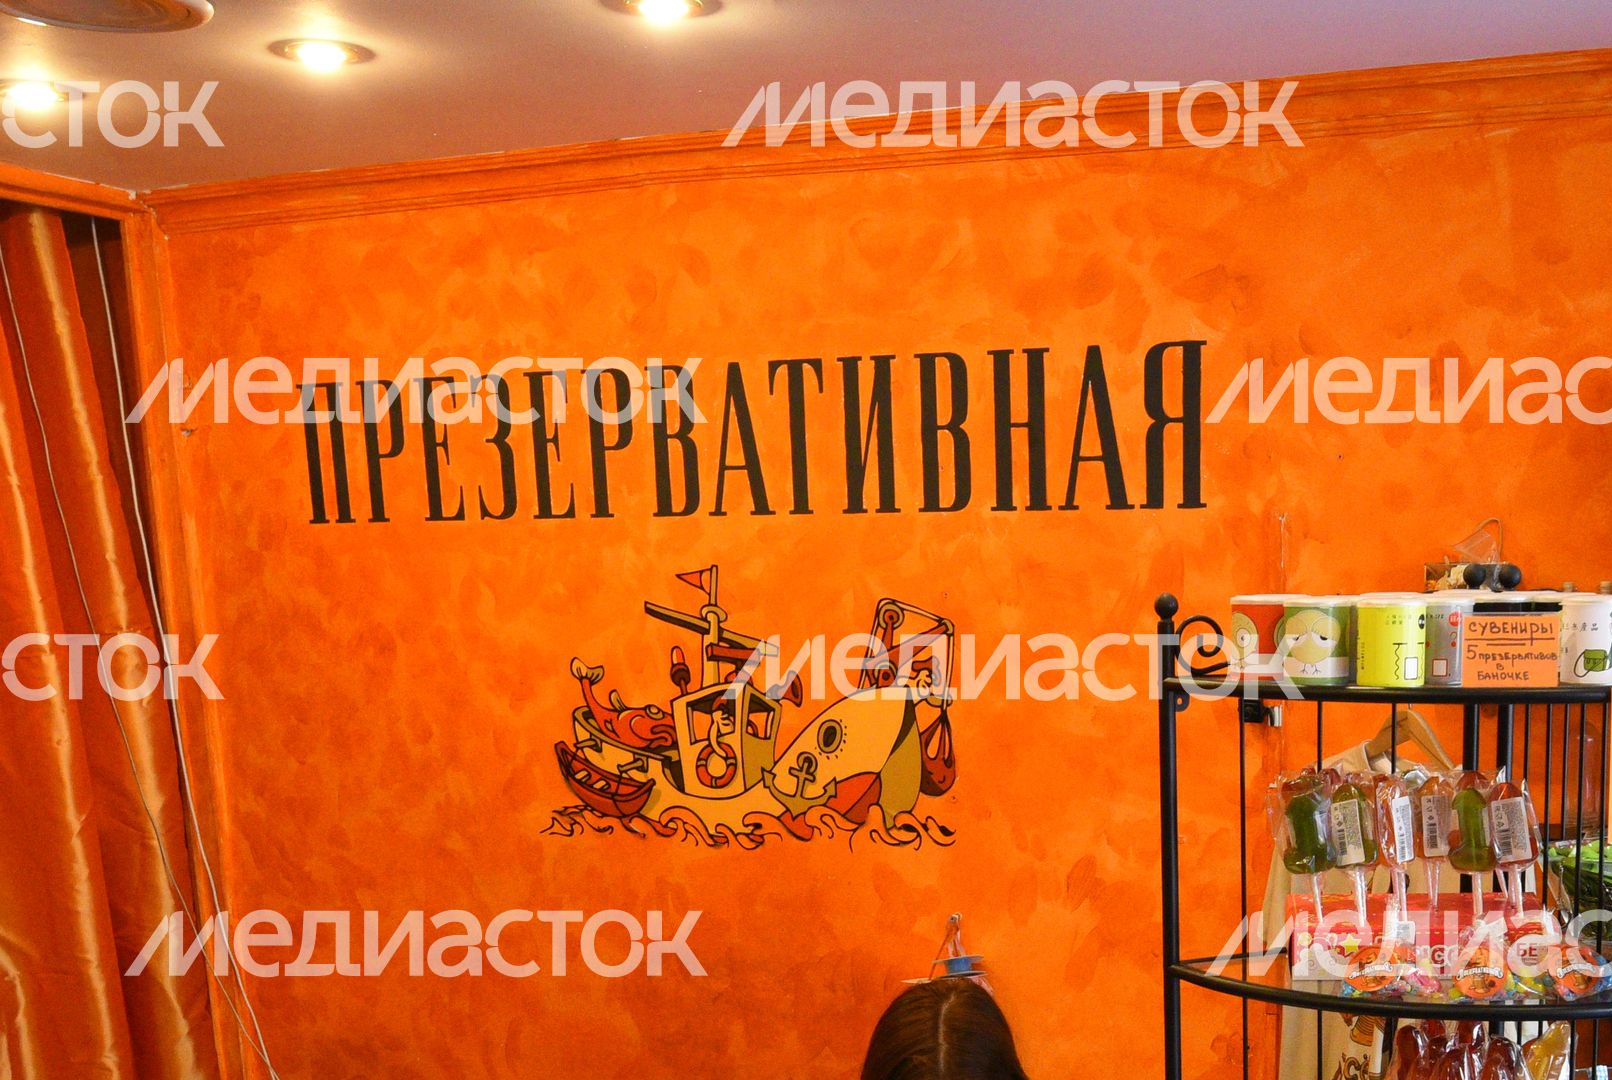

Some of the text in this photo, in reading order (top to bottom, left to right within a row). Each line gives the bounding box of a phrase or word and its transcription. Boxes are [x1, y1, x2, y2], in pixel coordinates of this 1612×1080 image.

[297, 341, 1206, 525] ПРЕЗЕРВАТИВНАЯ
[1466, 644, 1479, 661] 5
[1476, 670, 1531, 682] БАНОЧКЕ
